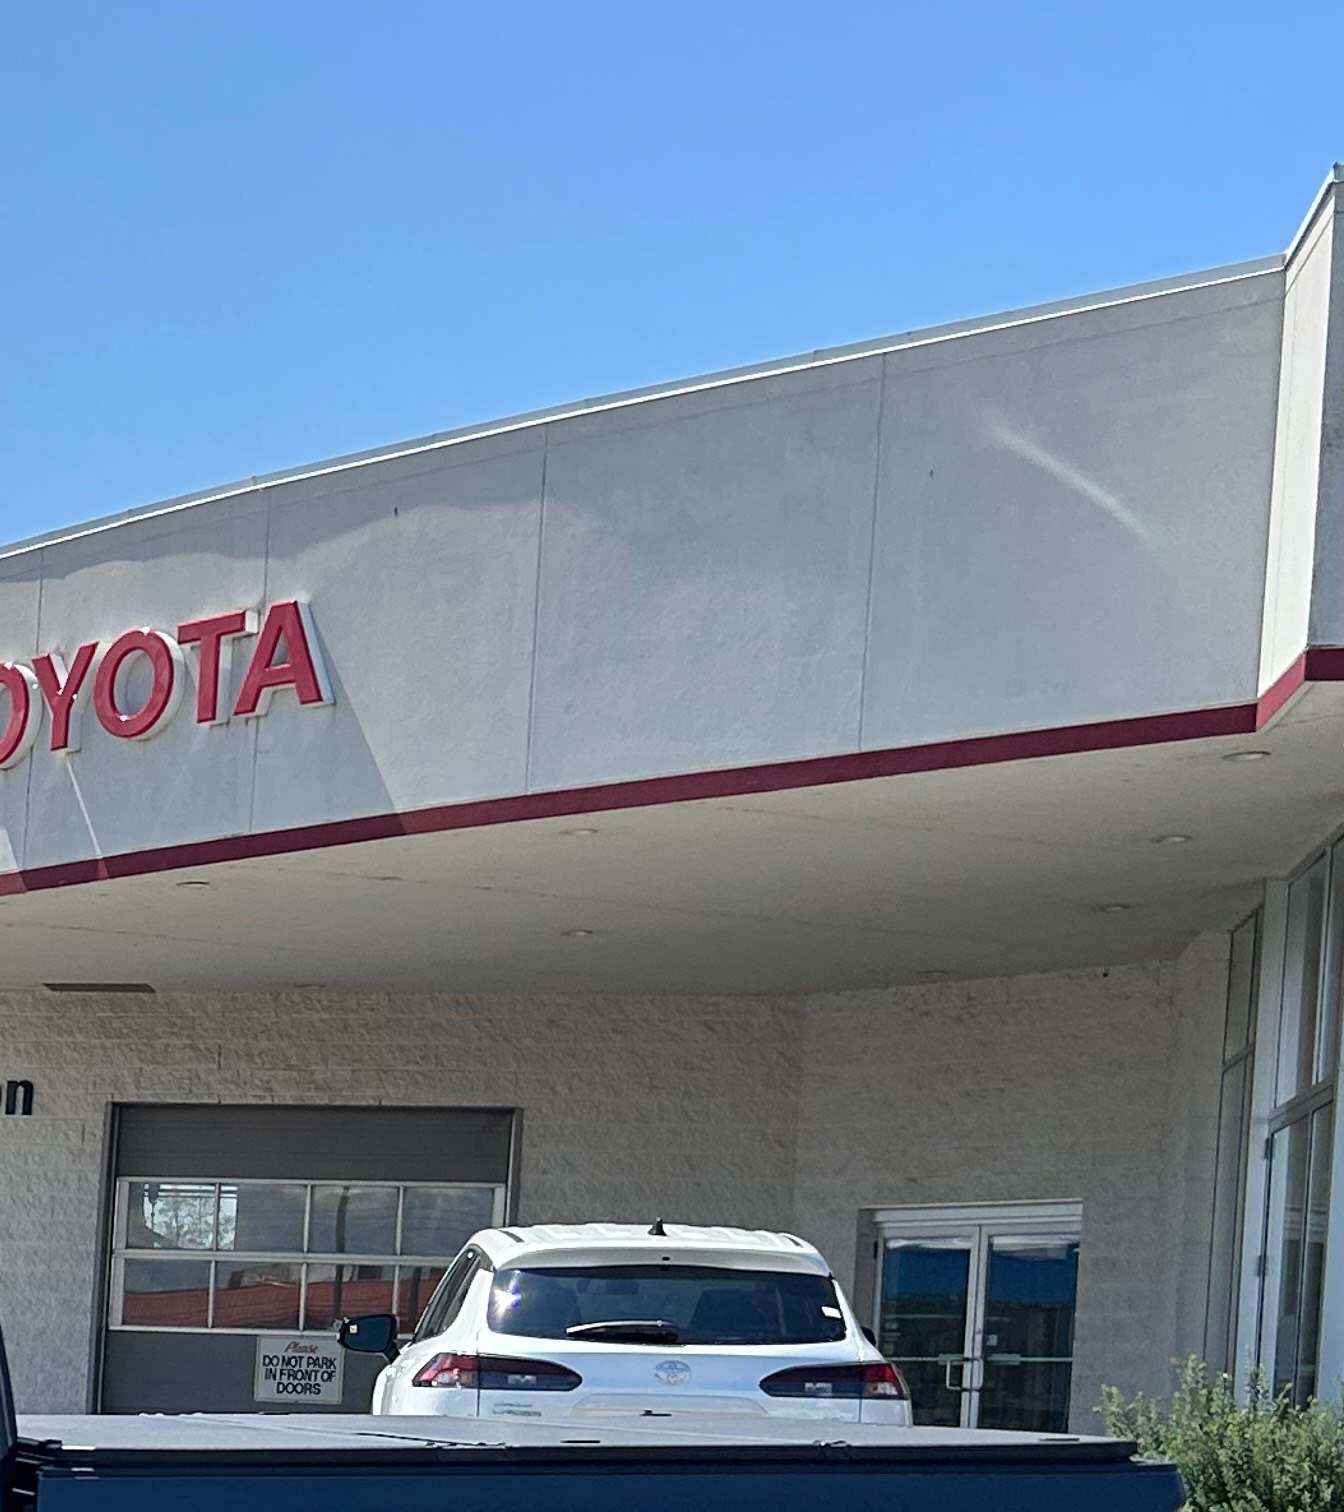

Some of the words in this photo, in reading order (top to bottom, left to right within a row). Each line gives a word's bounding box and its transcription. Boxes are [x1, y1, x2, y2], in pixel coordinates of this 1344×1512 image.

[262, 1355, 280, 1367] DO
[282, 1356, 305, 1369] NOT
[307, 1357, 336, 1370] PARK
[265, 1368, 277, 1381] IN
[279, 1369, 319, 1381] FRONT
[321, 1370, 336, 1382] OF
[276, 1382, 321, 1395] DOORS
